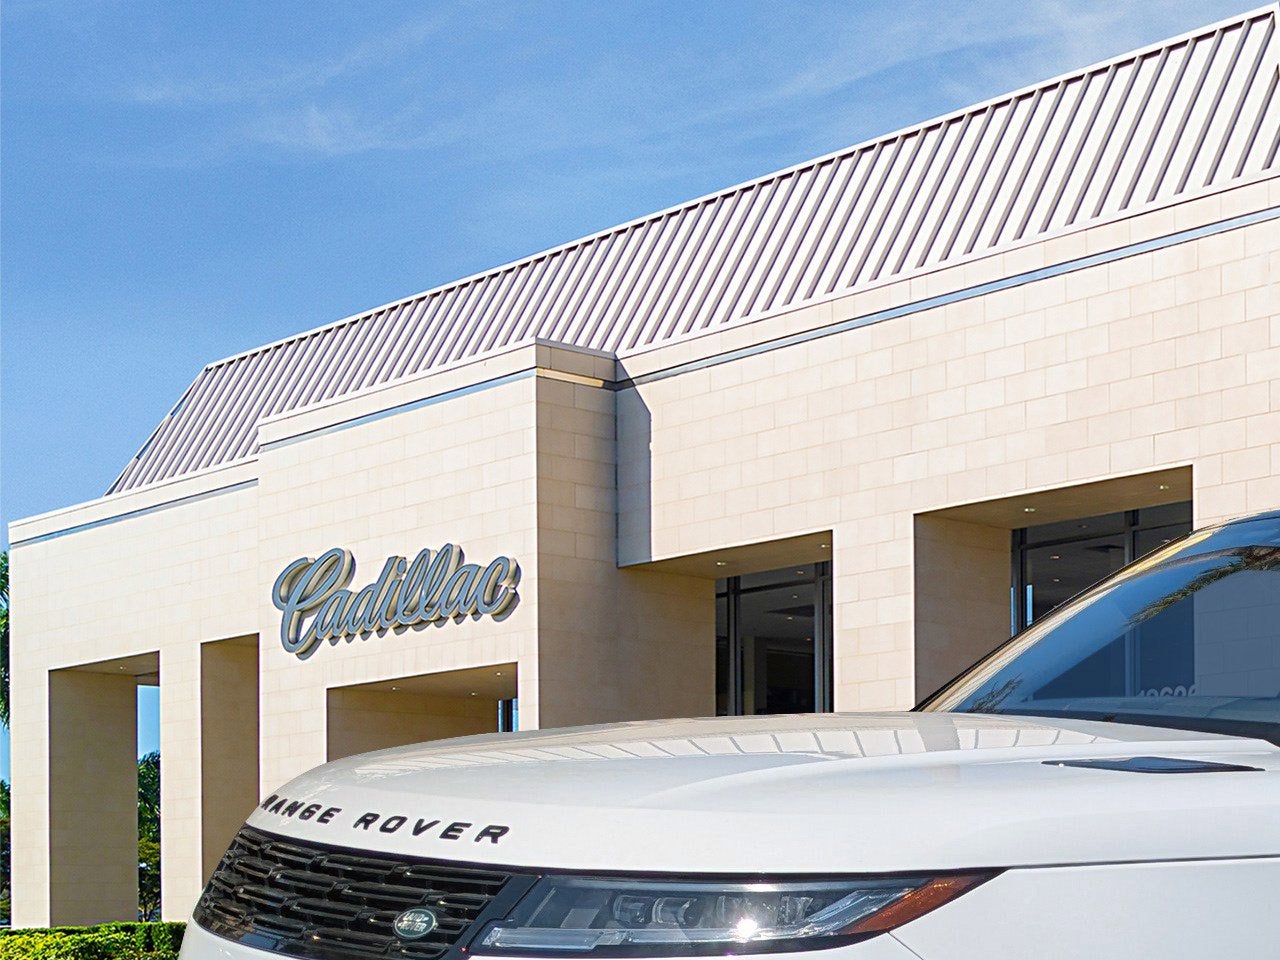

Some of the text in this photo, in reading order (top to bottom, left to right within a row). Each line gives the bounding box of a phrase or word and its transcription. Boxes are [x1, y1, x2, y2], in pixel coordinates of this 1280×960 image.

[272, 543, 522, 656] Cadillac
[260, 794, 510, 845] RANGE ROVER
